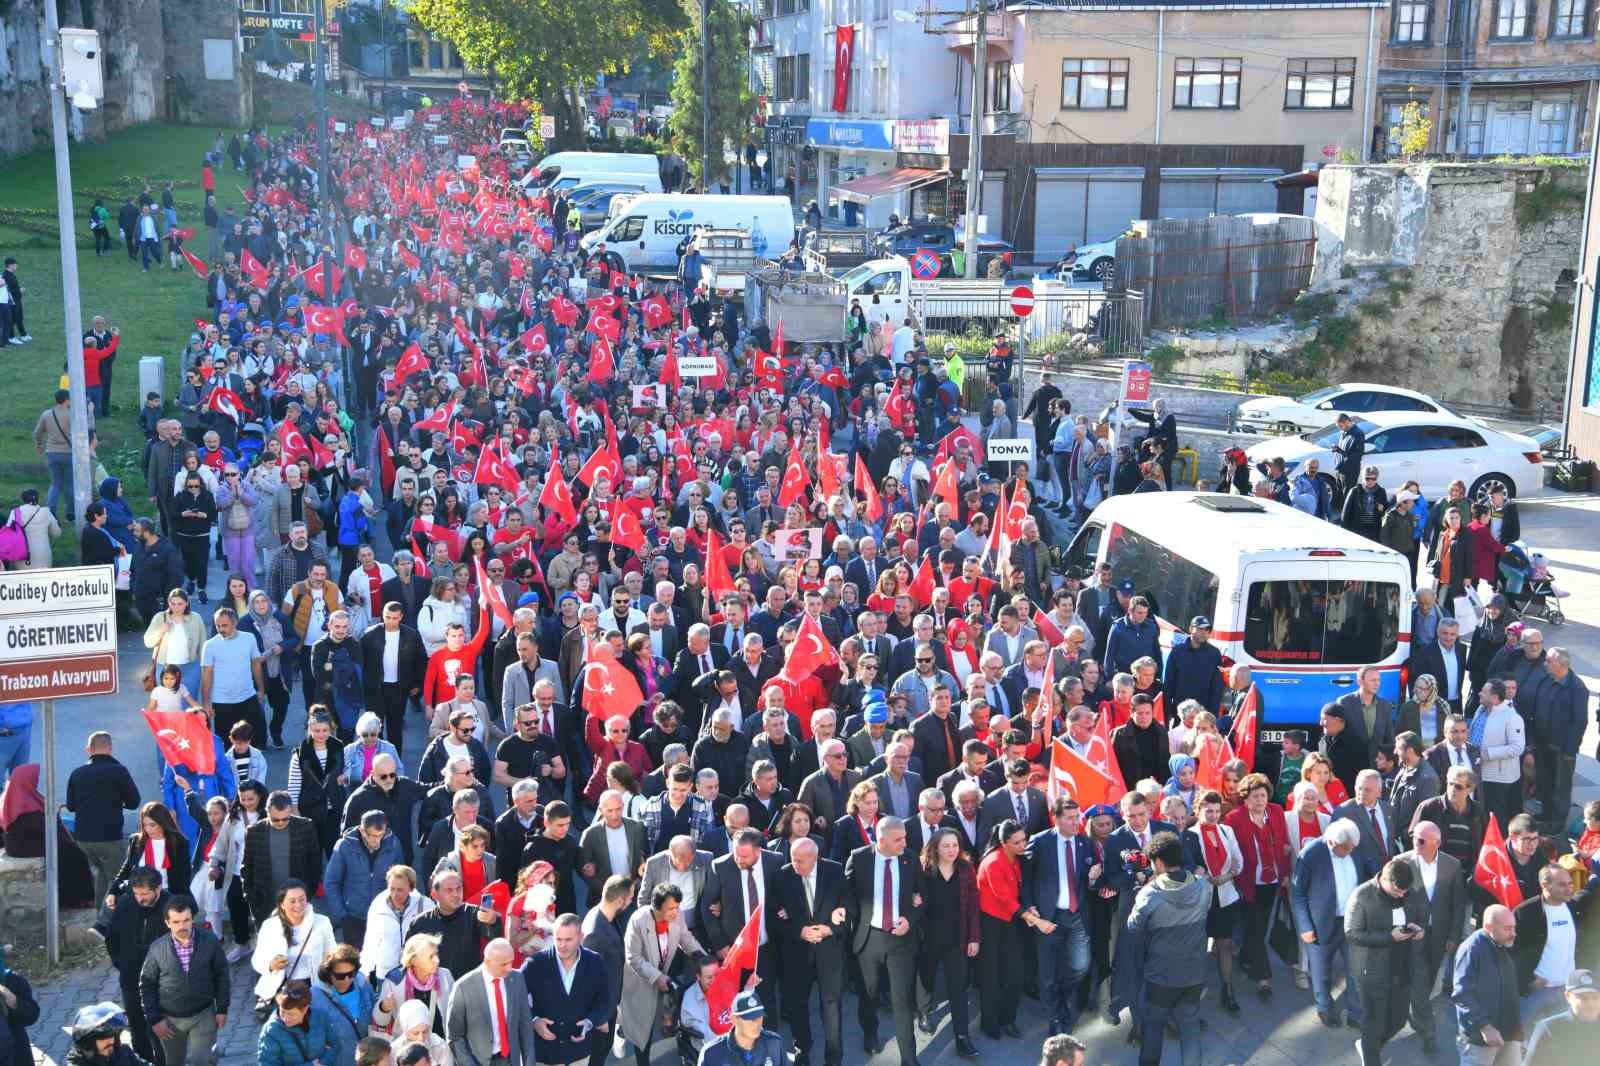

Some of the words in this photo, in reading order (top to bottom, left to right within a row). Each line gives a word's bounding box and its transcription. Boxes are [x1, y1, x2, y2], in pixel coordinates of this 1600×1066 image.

[990, 446, 1029, 454] TONYA
[0, 582, 48, 602] Cudibey
[51, 579, 109, 599] Ortaokulu
[7, 618, 108, 648] ÖĞRETMENEVİ
[1, 673, 49, 692] Trabzon
[52, 669, 110, 688] Akvaryum
